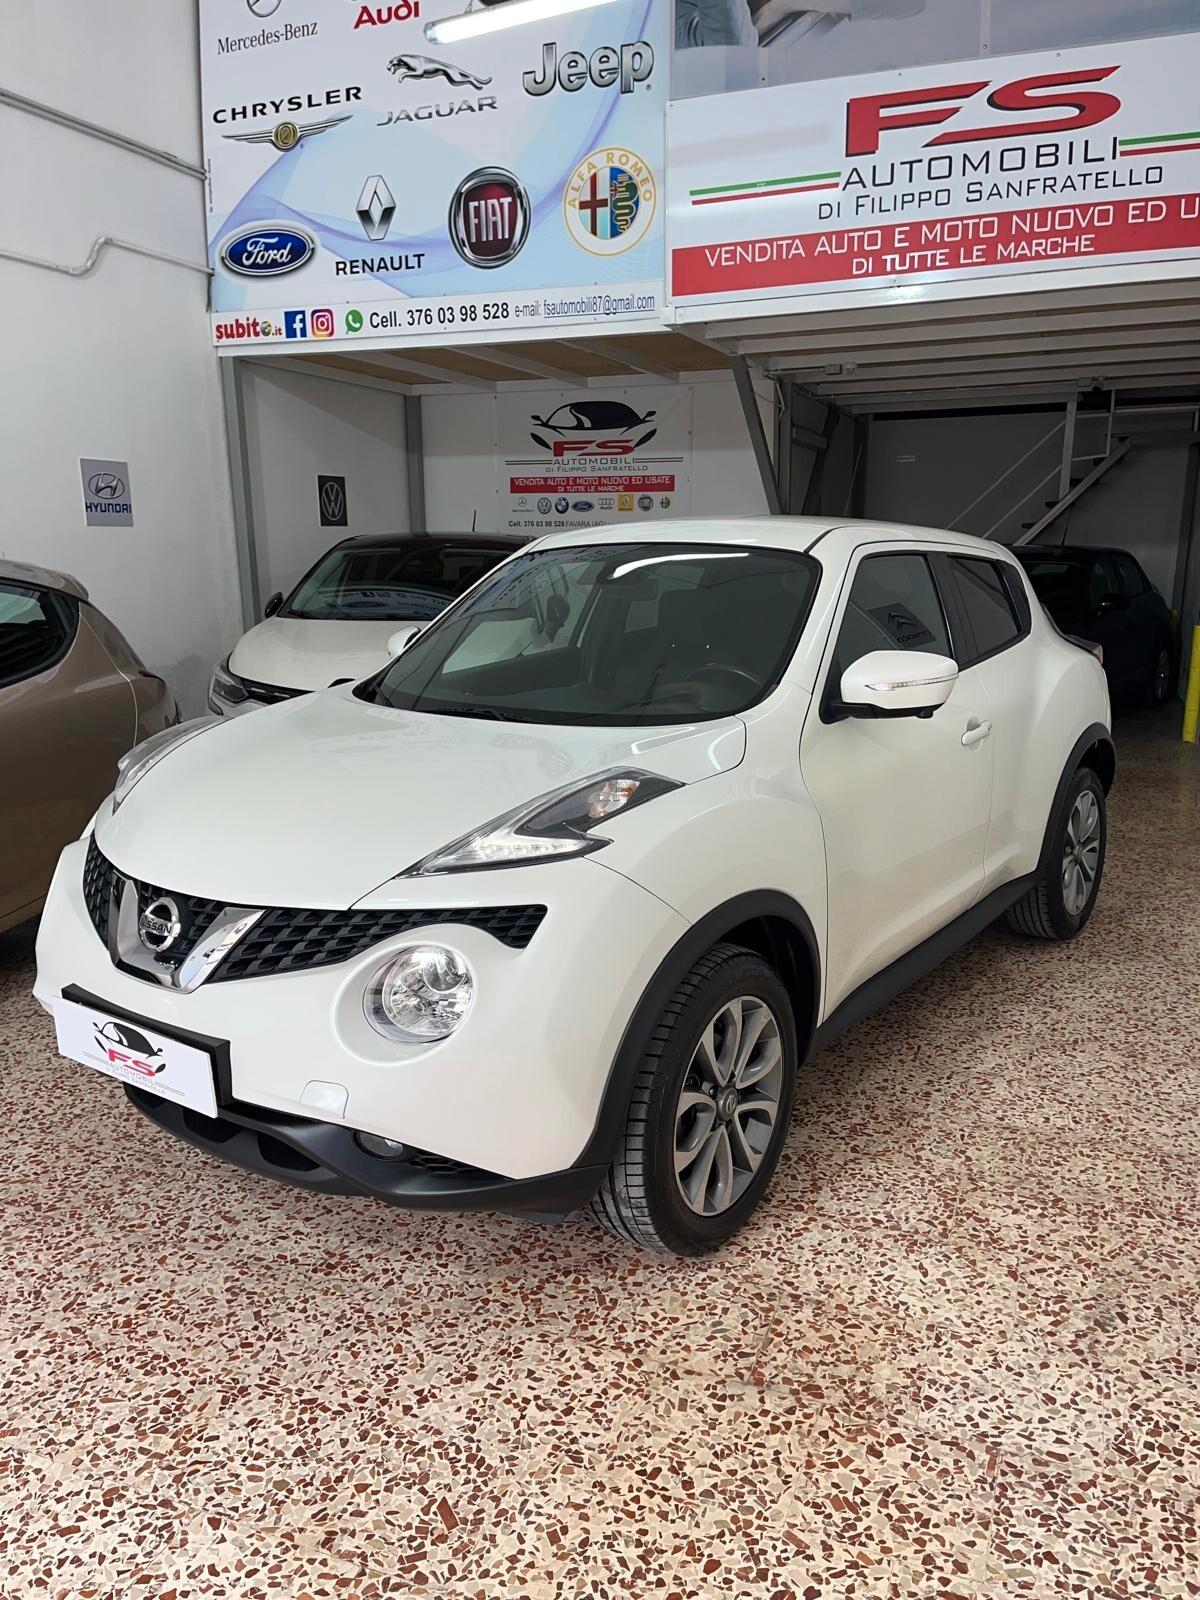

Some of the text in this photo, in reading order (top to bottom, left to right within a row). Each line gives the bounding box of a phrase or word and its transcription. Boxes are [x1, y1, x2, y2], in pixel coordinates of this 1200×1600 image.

[353, 0, 420, 29] Audi
[217, 22, 318, 55] Mercedes-Benz
[522, 41, 654, 96] Jeep
[213, 86, 362, 124] CHRYSLER
[377, 96, 498, 126] JAGUAR
[845, 65, 1122, 158] FS
[842, 136, 1118, 192] AUTOMOBILI
[567, 151, 653, 209] ALFA ROMEO
[818, 166, 1163, 220] DI FILIPPO SANFRATELLO
[468, 196, 513, 243] FIAT
[705, 239, 806, 267] VENDITA
[814, 229, 881, 257] AUTO
[894, 226, 910, 248] E
[921, 216, 999, 244] MOTO
[1012, 205, 1114, 235] NUOVO
[1128, 200, 1167, 224] ED
[242, 236, 293, 266] Ford
[335, 253, 425, 276] RENAULT
[852, 234, 1095, 275] DI TUTTE LE MARCHE
[370, 294, 655, 329] Cell. 376 03 98 528 e-mail: fsautomobili87@gmail.com
[553, 439, 635, 457] FS
[553, 457, 636, 466] AUTOMOBILI
[513, 475, 671, 487] VENDITA AUTO E MOTO NUOVO ED USATE
[557, 465, 587, 473] FILIPPO
[85, 501, 132, 514] HYUNDAI
[565, 520, 591, 528] FAVARA
[108, 1048, 156, 1077] FS
